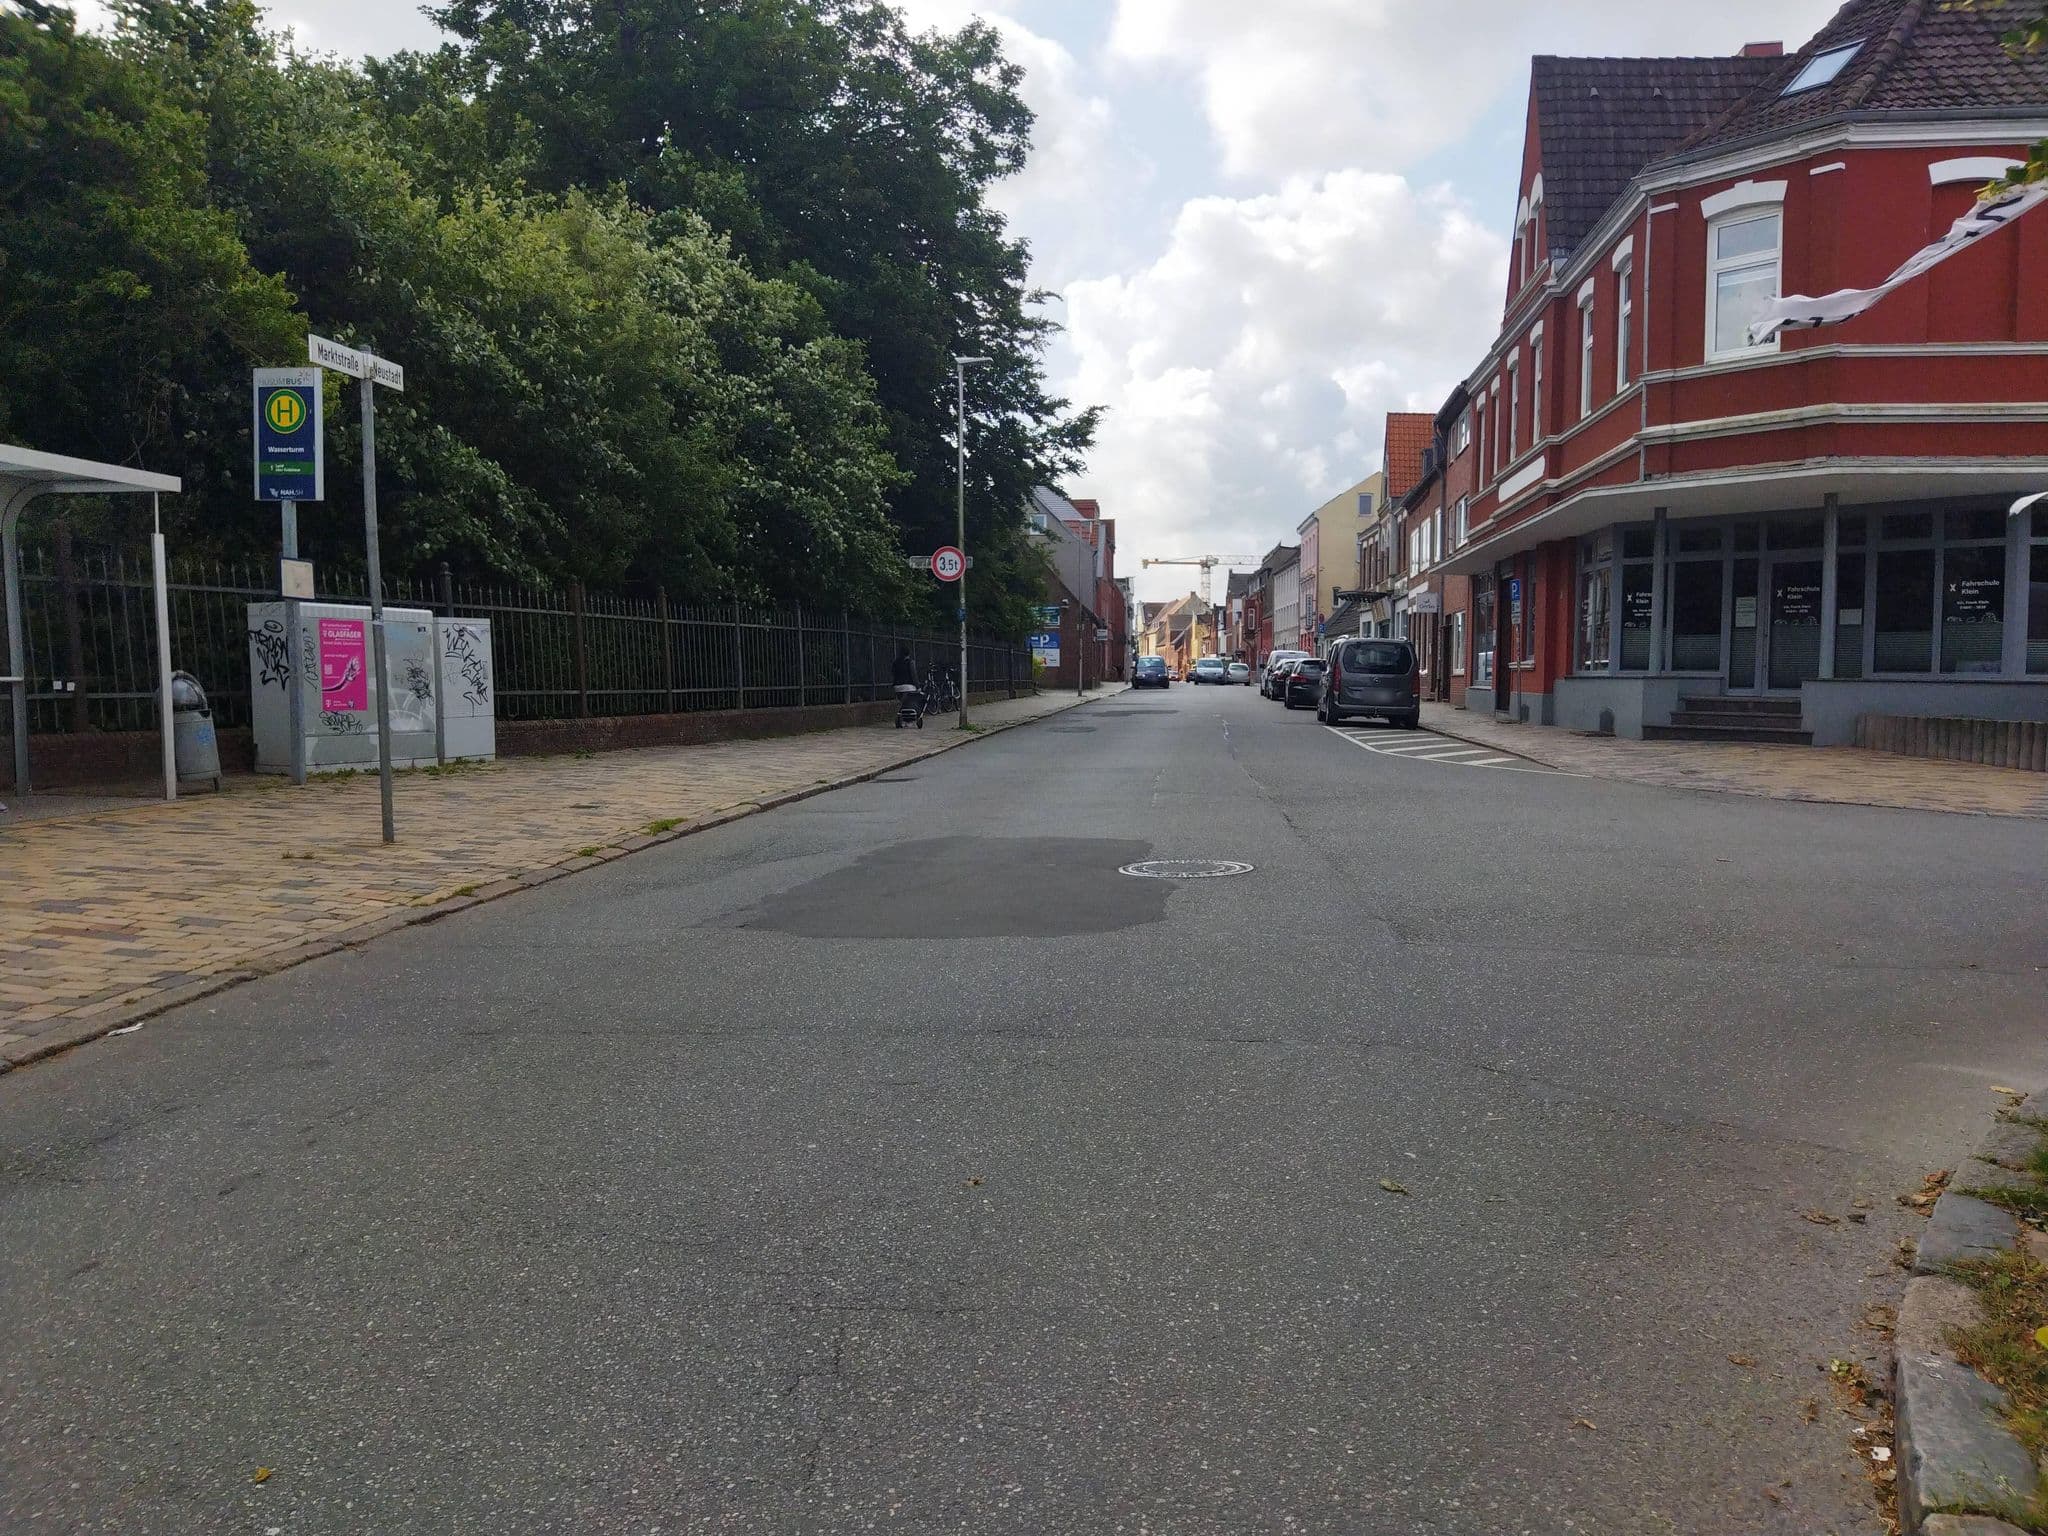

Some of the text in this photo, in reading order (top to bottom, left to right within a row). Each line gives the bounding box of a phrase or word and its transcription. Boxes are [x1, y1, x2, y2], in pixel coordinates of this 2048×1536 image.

[317, 342, 360, 372] Marktstraße
[372, 360, 402, 386] Neustadt
[277, 399, 293, 423] H
[1961, 579, 2000, 587] Fahrschule
